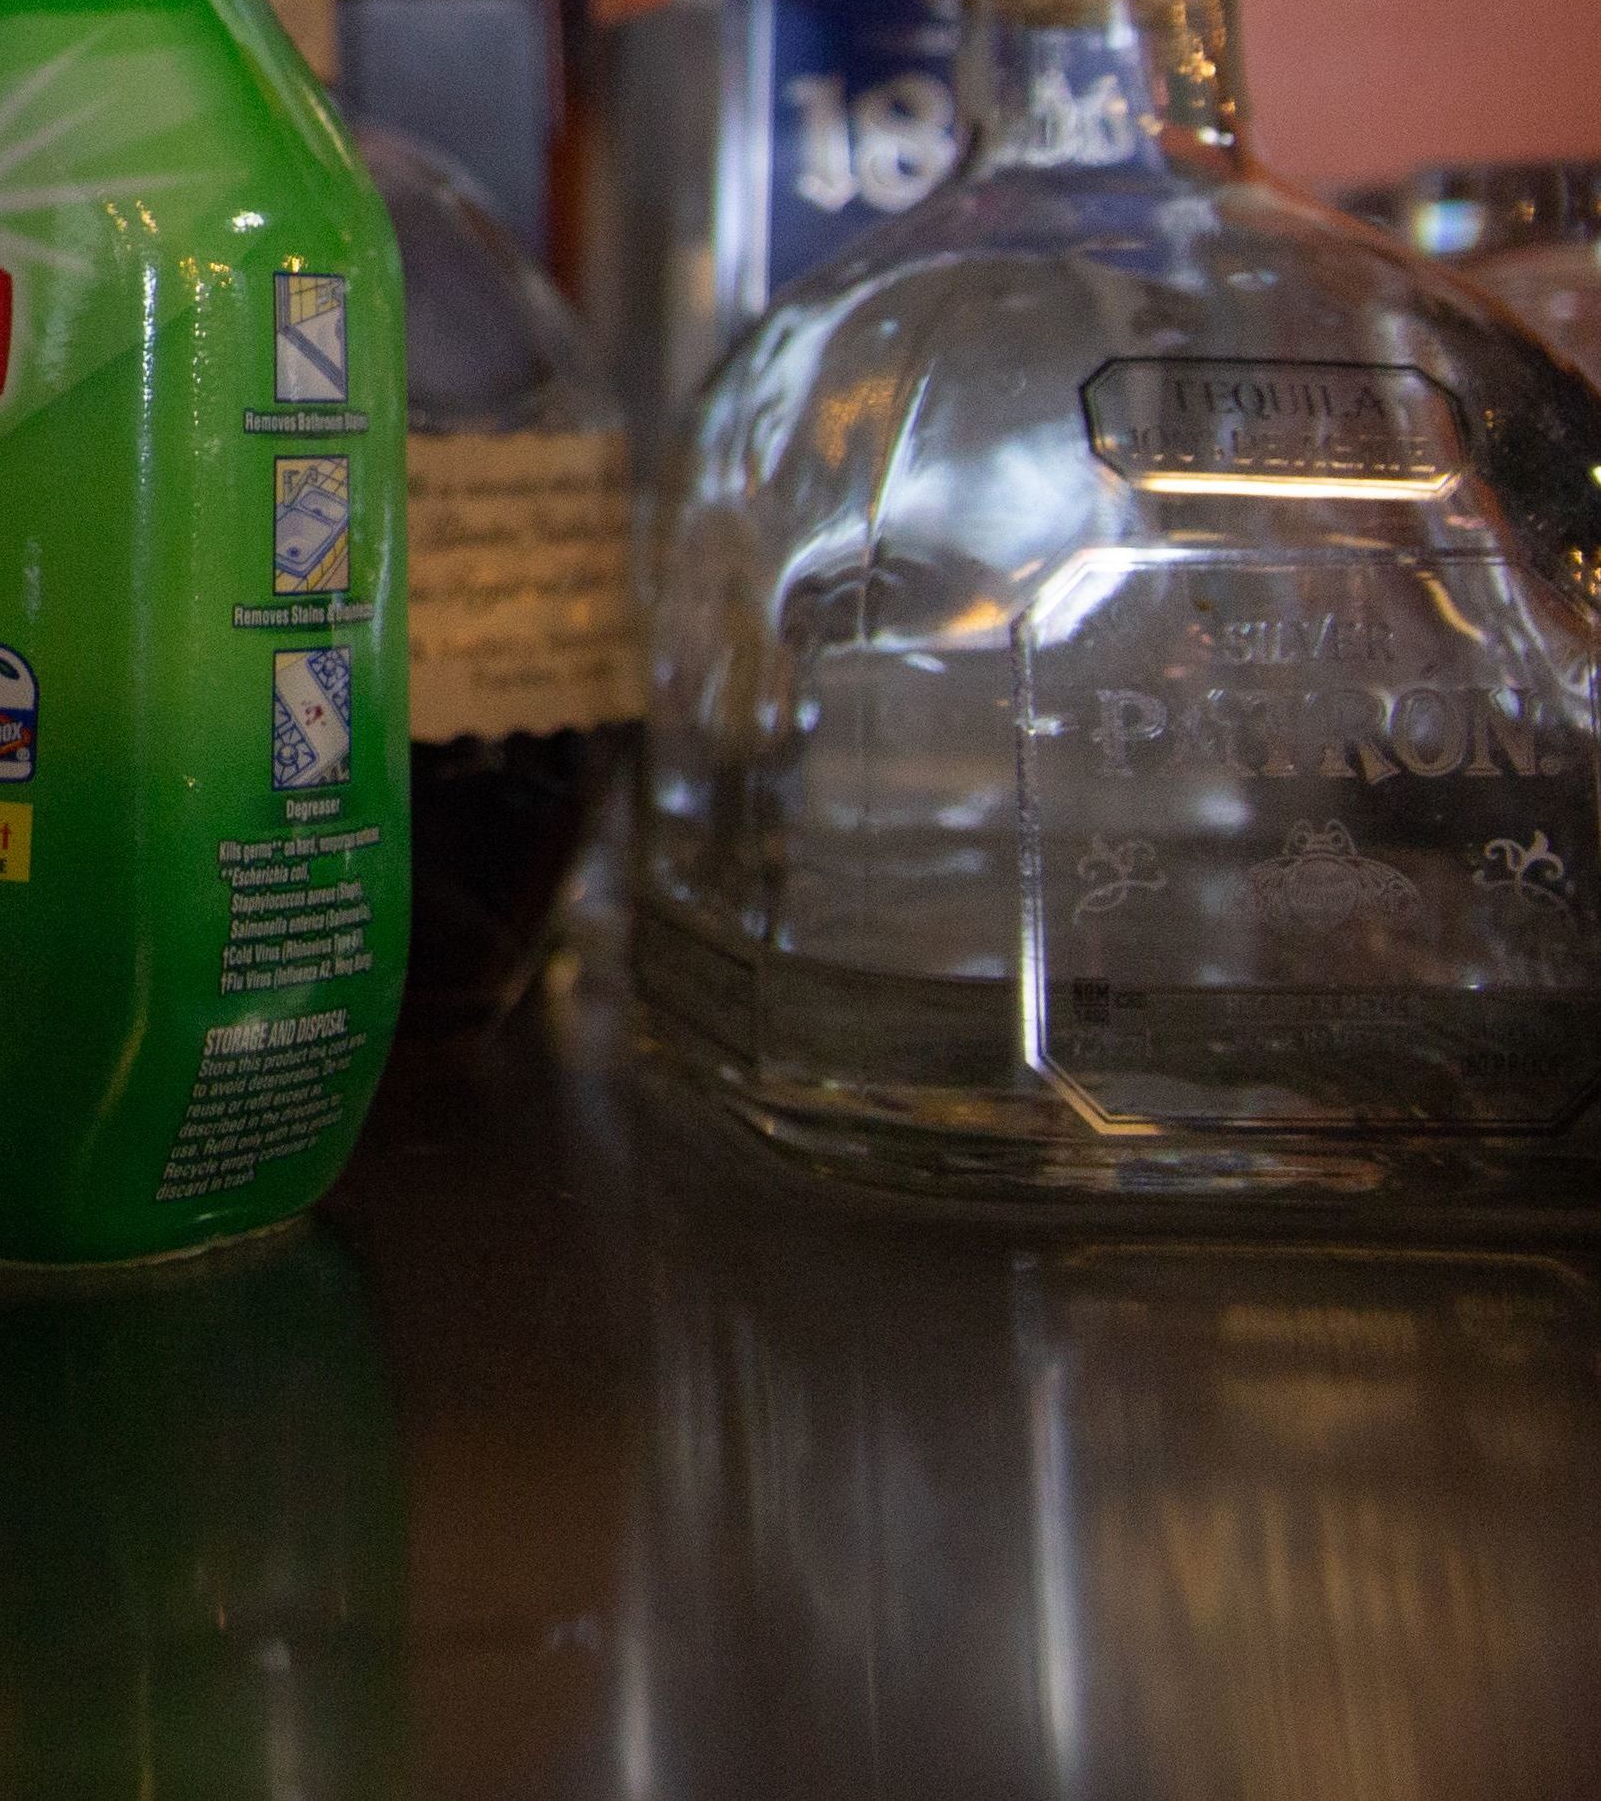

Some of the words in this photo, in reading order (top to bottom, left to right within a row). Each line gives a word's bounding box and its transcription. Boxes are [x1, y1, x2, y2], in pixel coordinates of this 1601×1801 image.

[1172, 379, 1389, 420] TEQUILA
[234, 605, 288, 626] Removes
[290, 603, 326, 624] Stains
[1223, 615, 1396, 664] SILVER
[285, 799, 341, 821] Degreaser
[218, 840, 242, 861] Kills
[203, 1020, 269, 1056] STORAGE
[268, 1019, 297, 1049] AND
[199, 1057, 237, 1078] Store
[238, 1054, 261, 1074] this
[192, 1083, 208, 1100] to
[209, 1078, 247, 1097] avoid
[186, 1103, 227, 1119] reuse
[178, 1115, 248, 1139] described
[163, 1160, 221, 1181] Recycle
[156, 1176, 209, 1202] discard
